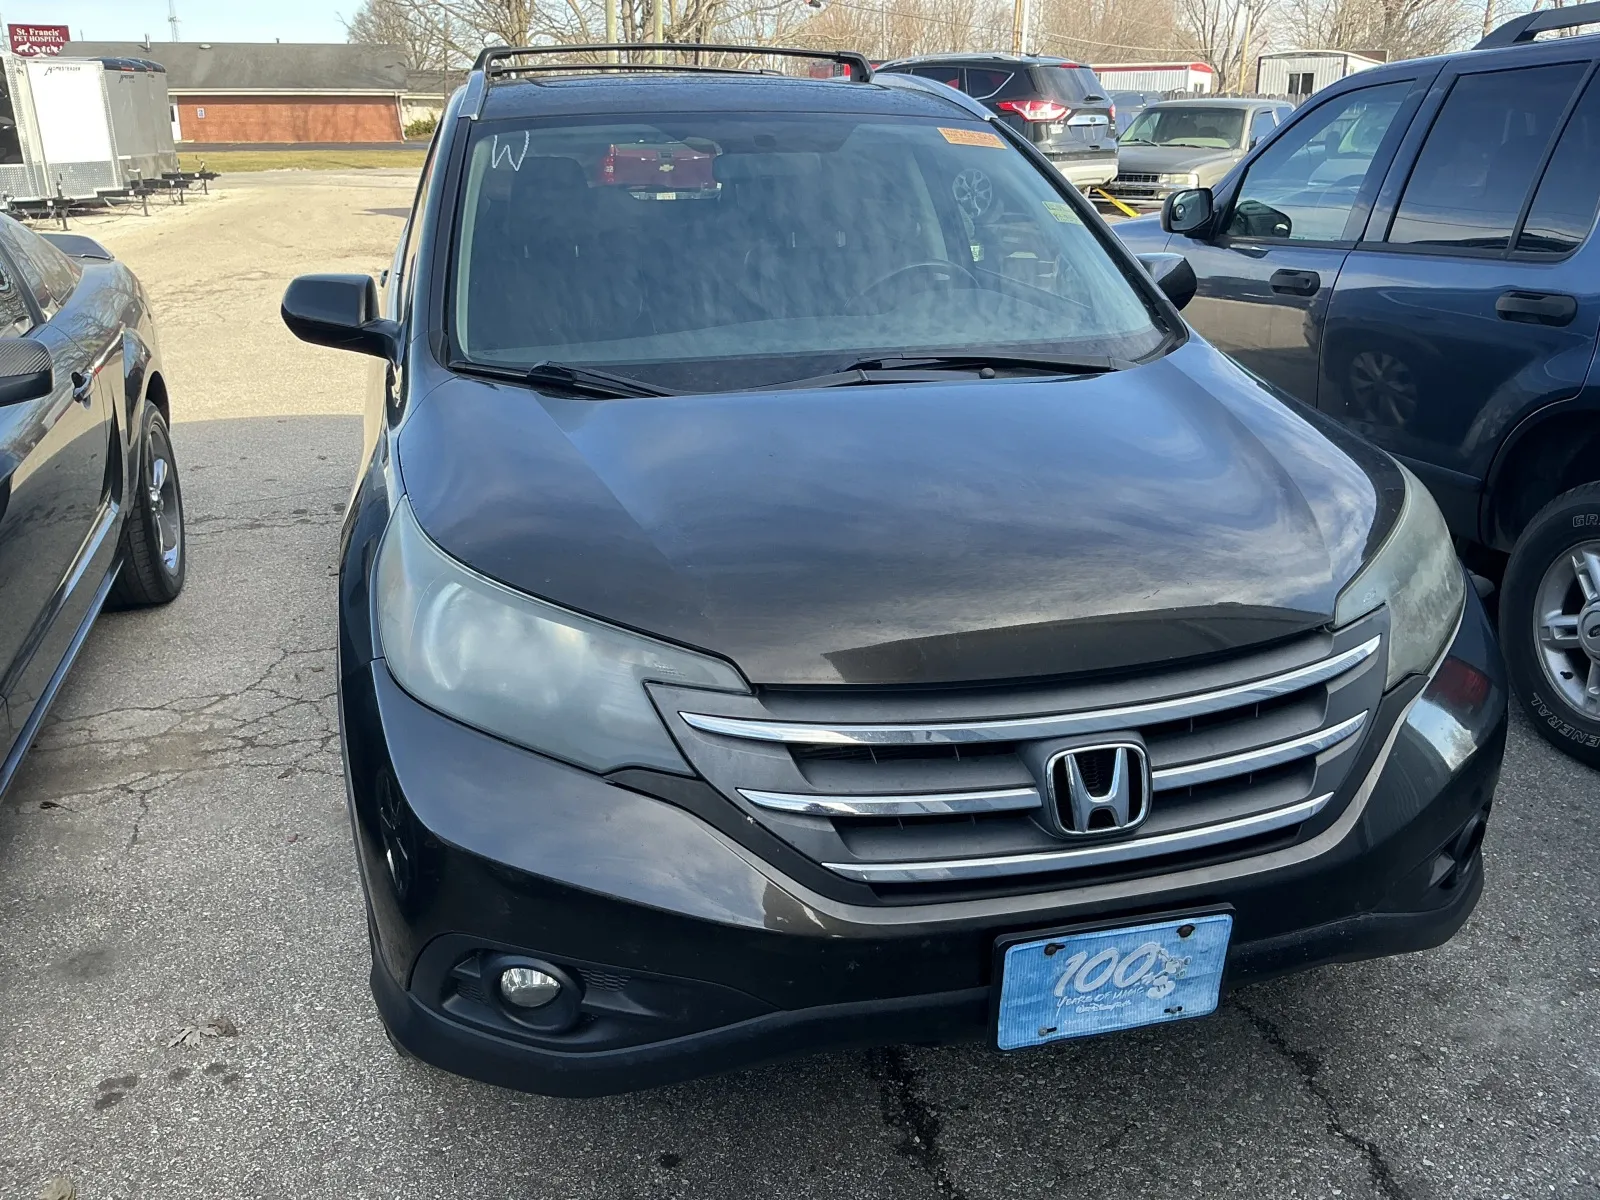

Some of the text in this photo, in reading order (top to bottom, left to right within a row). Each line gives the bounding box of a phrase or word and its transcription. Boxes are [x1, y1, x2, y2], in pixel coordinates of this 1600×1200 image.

[16, 28, 28, 36] St.
[491, 130, 530, 172] W
[1572, 513, 1600, 528] GR
[1531, 692, 1600, 748] ENERAL
[1054, 942, 1159, 997] 100
